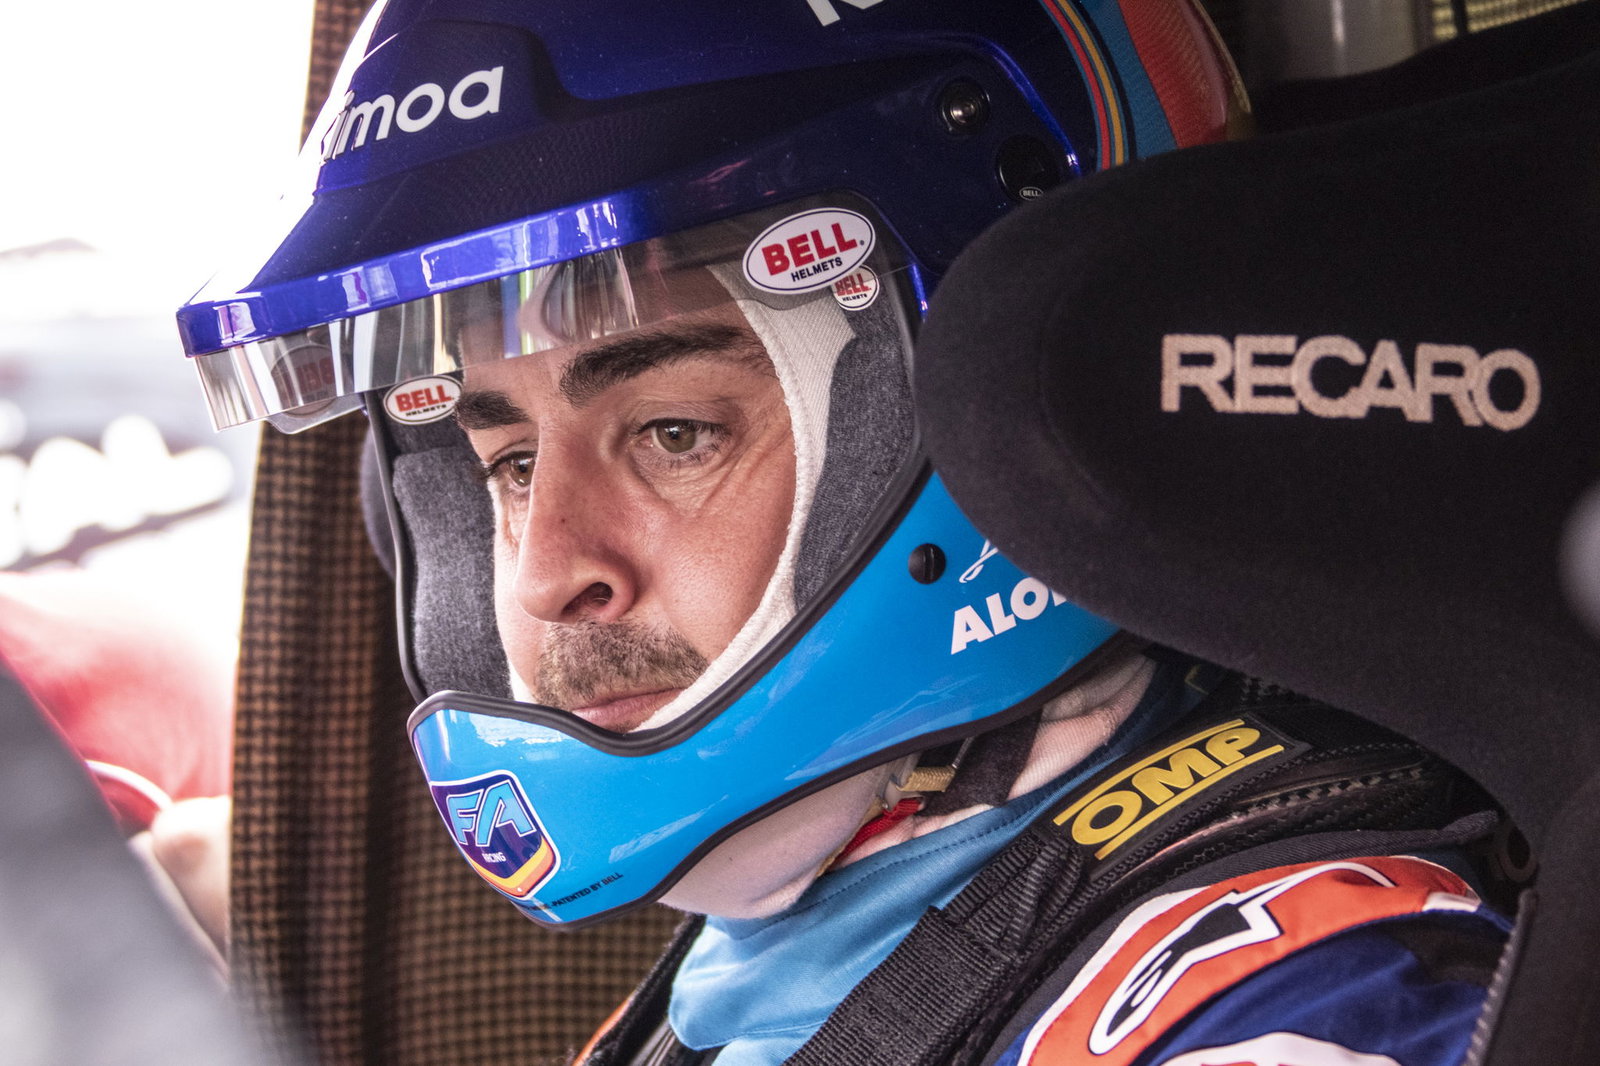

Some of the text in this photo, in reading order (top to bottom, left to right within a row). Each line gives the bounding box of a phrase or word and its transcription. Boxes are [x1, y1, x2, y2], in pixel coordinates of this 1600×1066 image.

[320, 66, 504, 161] imoa
[761, 222, 858, 276] BELL
[790, 256, 843, 282] HELMETS
[834, 272, 870, 297] BELL
[394, 384, 453, 412] BELL
[1161, 333, 1542, 432] RECARO
[951, 576, 1068, 655] ALO
[446, 779, 537, 847] FA
[1071, 727, 1261, 845] OMP
[590, 880, 604, 891] BY
[602, 872, 624, 886] BELL
